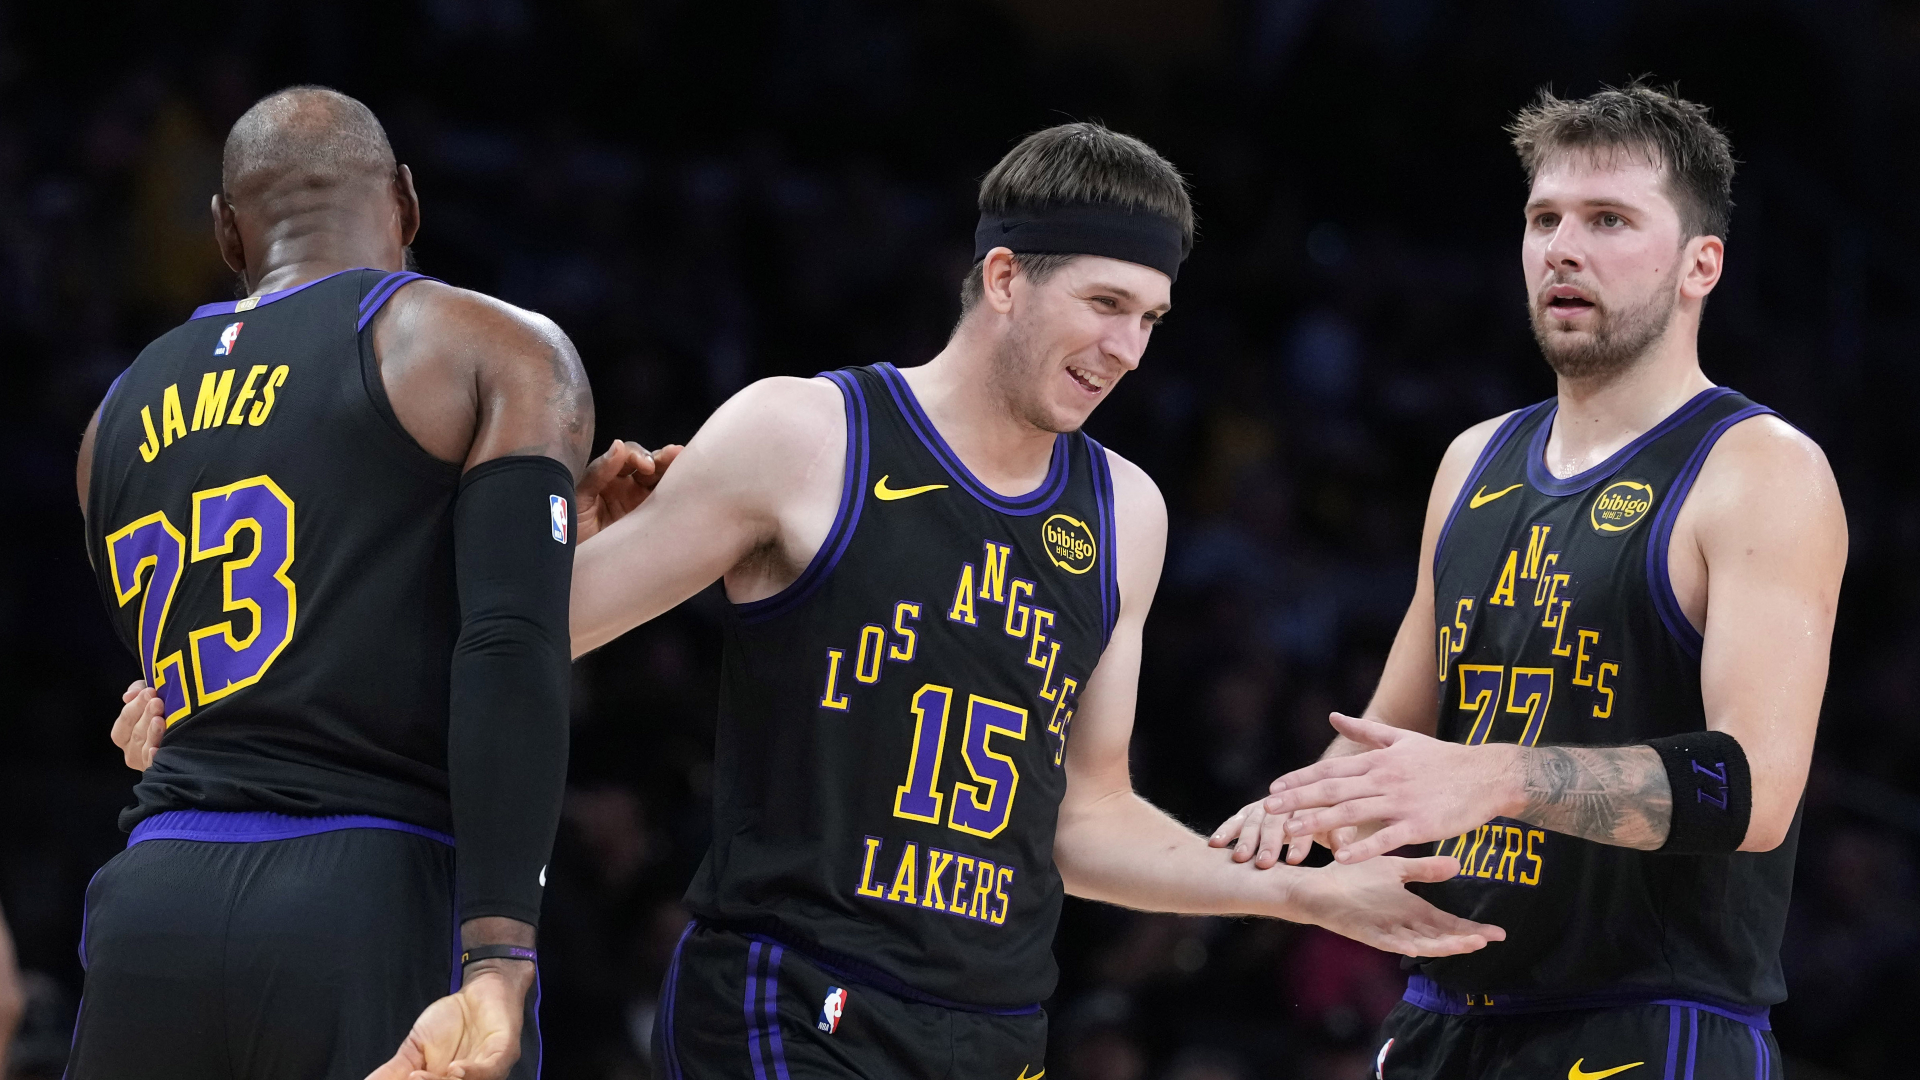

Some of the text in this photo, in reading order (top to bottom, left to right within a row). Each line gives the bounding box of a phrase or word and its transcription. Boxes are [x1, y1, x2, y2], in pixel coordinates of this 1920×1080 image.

[139, 364, 289, 462] JAMES
[1047, 525, 1093, 559] bibigo
[1597, 493, 1648, 517] bibigo
[1056, 545, 1075, 560] 비비고
[105, 474, 297, 729] 23
[1438, 522, 1622, 719] OS ANGELES
[820, 540, 1078, 767] LOS ANGELES
[1458, 664, 1554, 747] 77
[893, 684, 1028, 839] 15
[855, 835, 1016, 926] LAKERS
[818, 1021, 830, 1031] NBA
